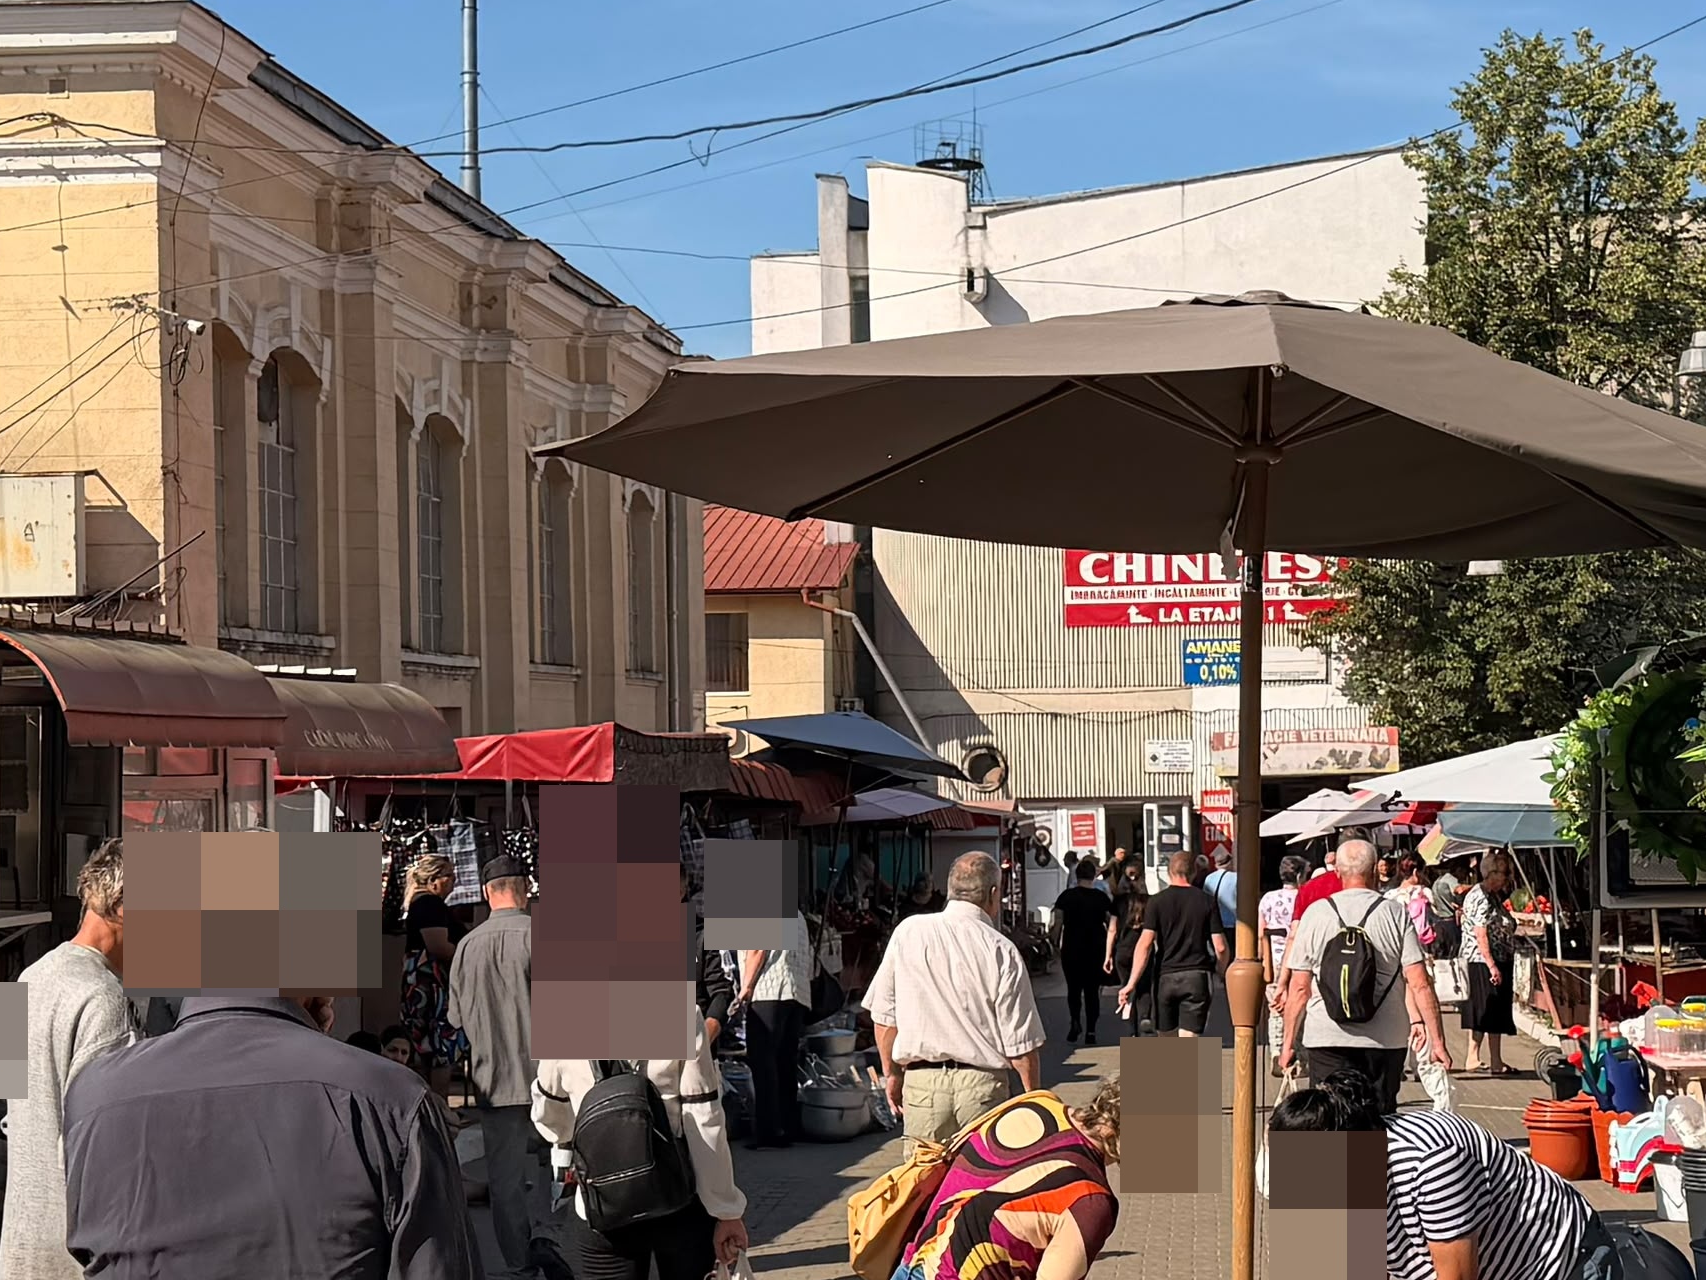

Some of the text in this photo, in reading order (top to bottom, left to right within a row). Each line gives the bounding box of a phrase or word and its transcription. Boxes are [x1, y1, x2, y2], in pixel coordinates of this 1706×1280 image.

[1158, 606, 1182, 623] LA
[1186, 640, 1242, 655] AMANE
[1199, 664, 1238, 682] 0,10%
